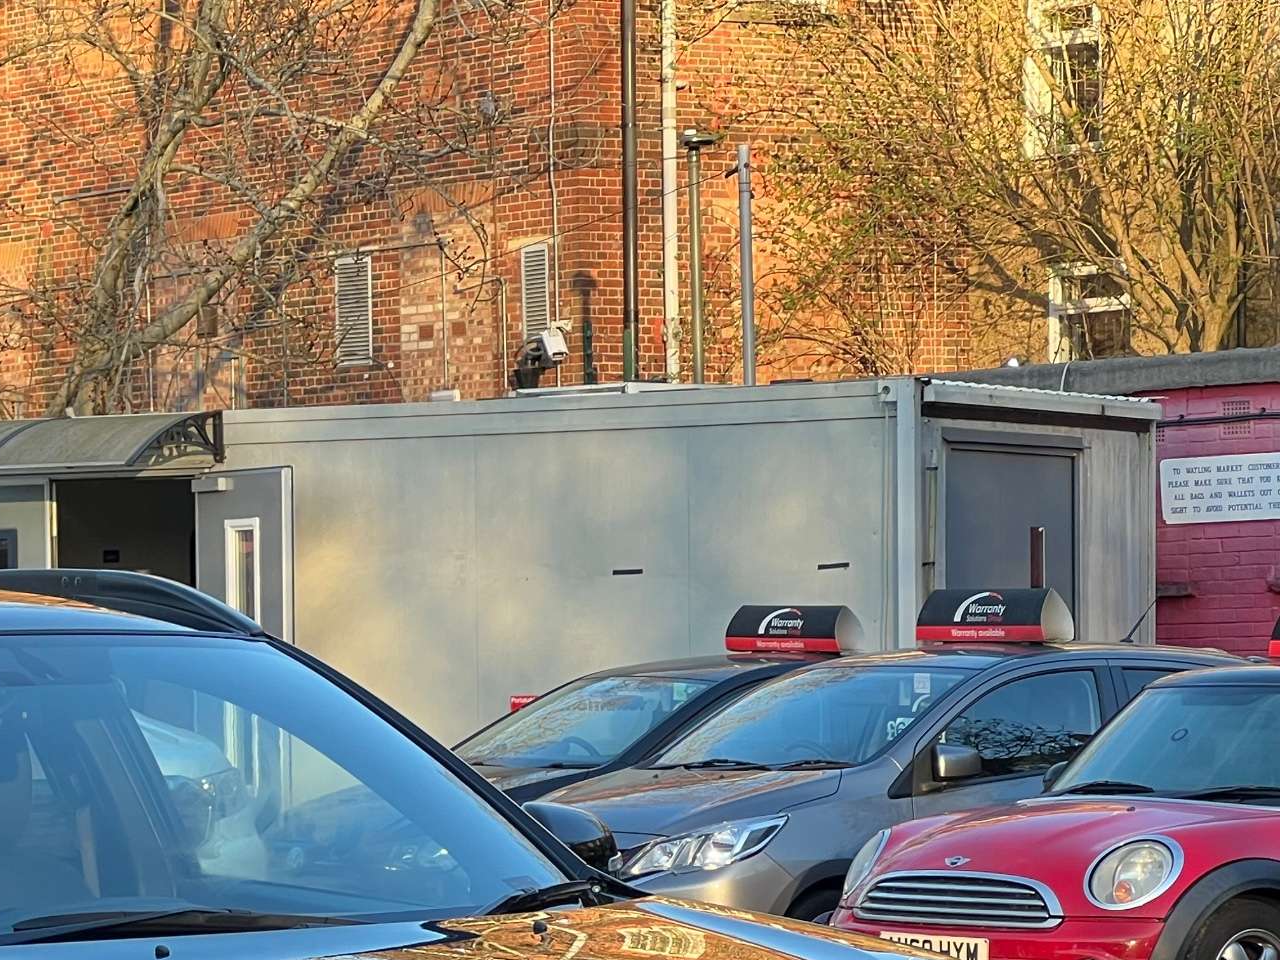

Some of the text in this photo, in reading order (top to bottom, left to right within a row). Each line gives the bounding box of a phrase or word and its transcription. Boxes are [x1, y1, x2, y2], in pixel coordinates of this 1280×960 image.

[1216, 464, 1242, 472] MARKET
[1168, 480, 1189, 488] PLEASE
[1237, 476, 1254, 484] THAT
[1260, 475, 1271, 483] YOU
[1190, 492, 1204, 500] BAGS
[1209, 491, 1223, 499] AND
[1228, 490, 1255, 498] WALLETS
[1171, 506, 1187, 514] SIGHT
[1227, 502, 1263, 511] POTENTIAL
[969, 603, 1006, 616] Warranty
[771, 617, 804, 629] Warranty
[951, 628, 1005, 638] Warranty available
